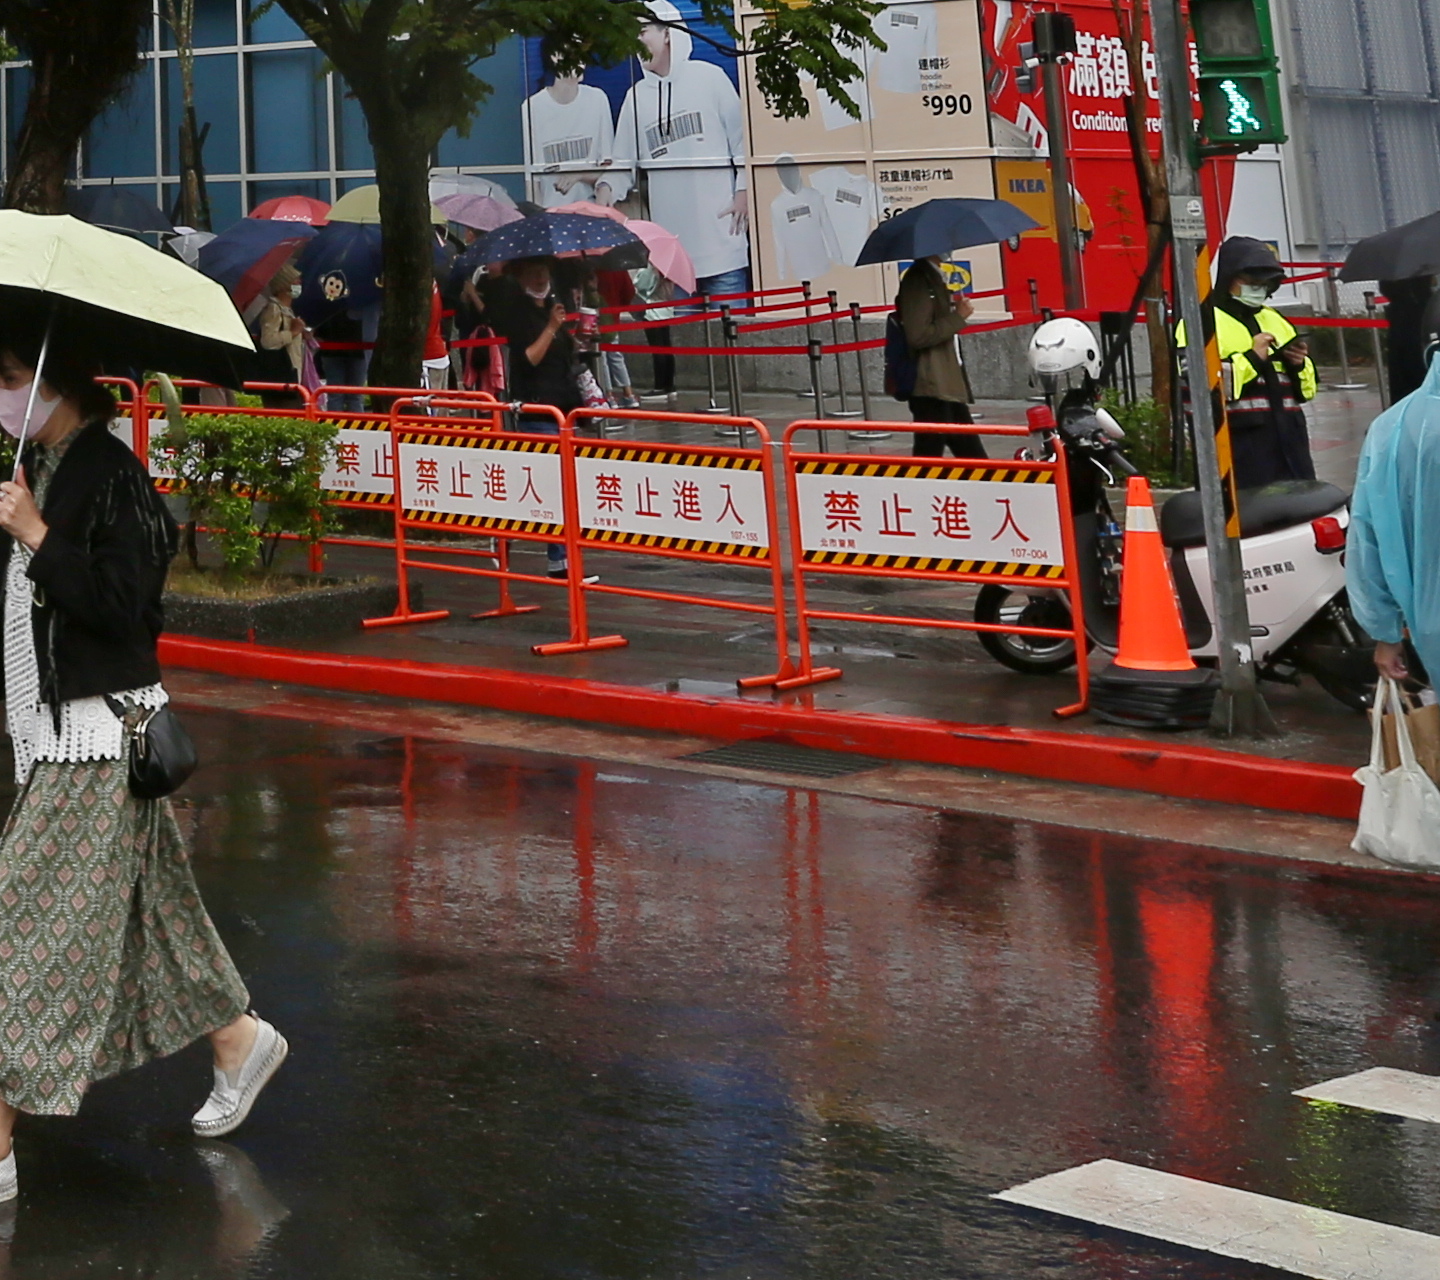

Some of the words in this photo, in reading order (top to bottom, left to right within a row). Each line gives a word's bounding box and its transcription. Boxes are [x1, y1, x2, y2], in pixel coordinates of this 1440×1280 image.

[922, 94, 972, 116] $990
[1008, 179, 1046, 193] IKEA
[415, 457, 544, 505] 禁止進入
[595, 473, 745, 526] 禁止進入
[823, 490, 1031, 543] 禁止進入
[1010, 547, 1049, 560] 107-004
